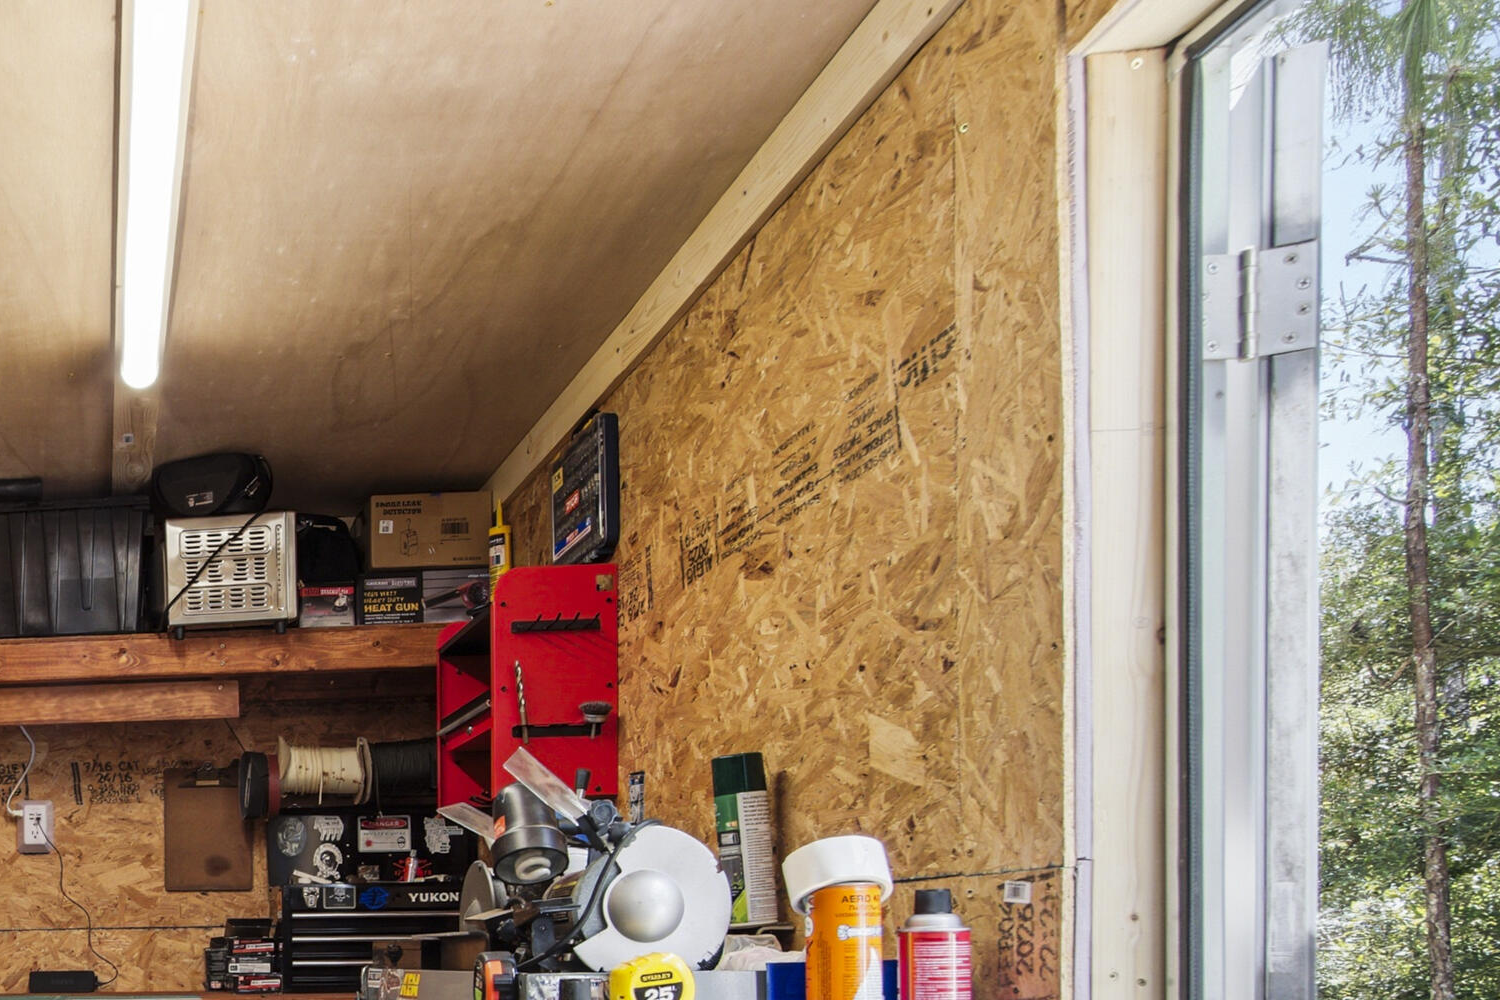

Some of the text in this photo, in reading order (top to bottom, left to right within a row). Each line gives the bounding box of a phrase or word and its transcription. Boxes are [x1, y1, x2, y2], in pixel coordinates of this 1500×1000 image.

[363, 602, 420, 612] HEAT GUN
[407, 891, 460, 903] YUKON
